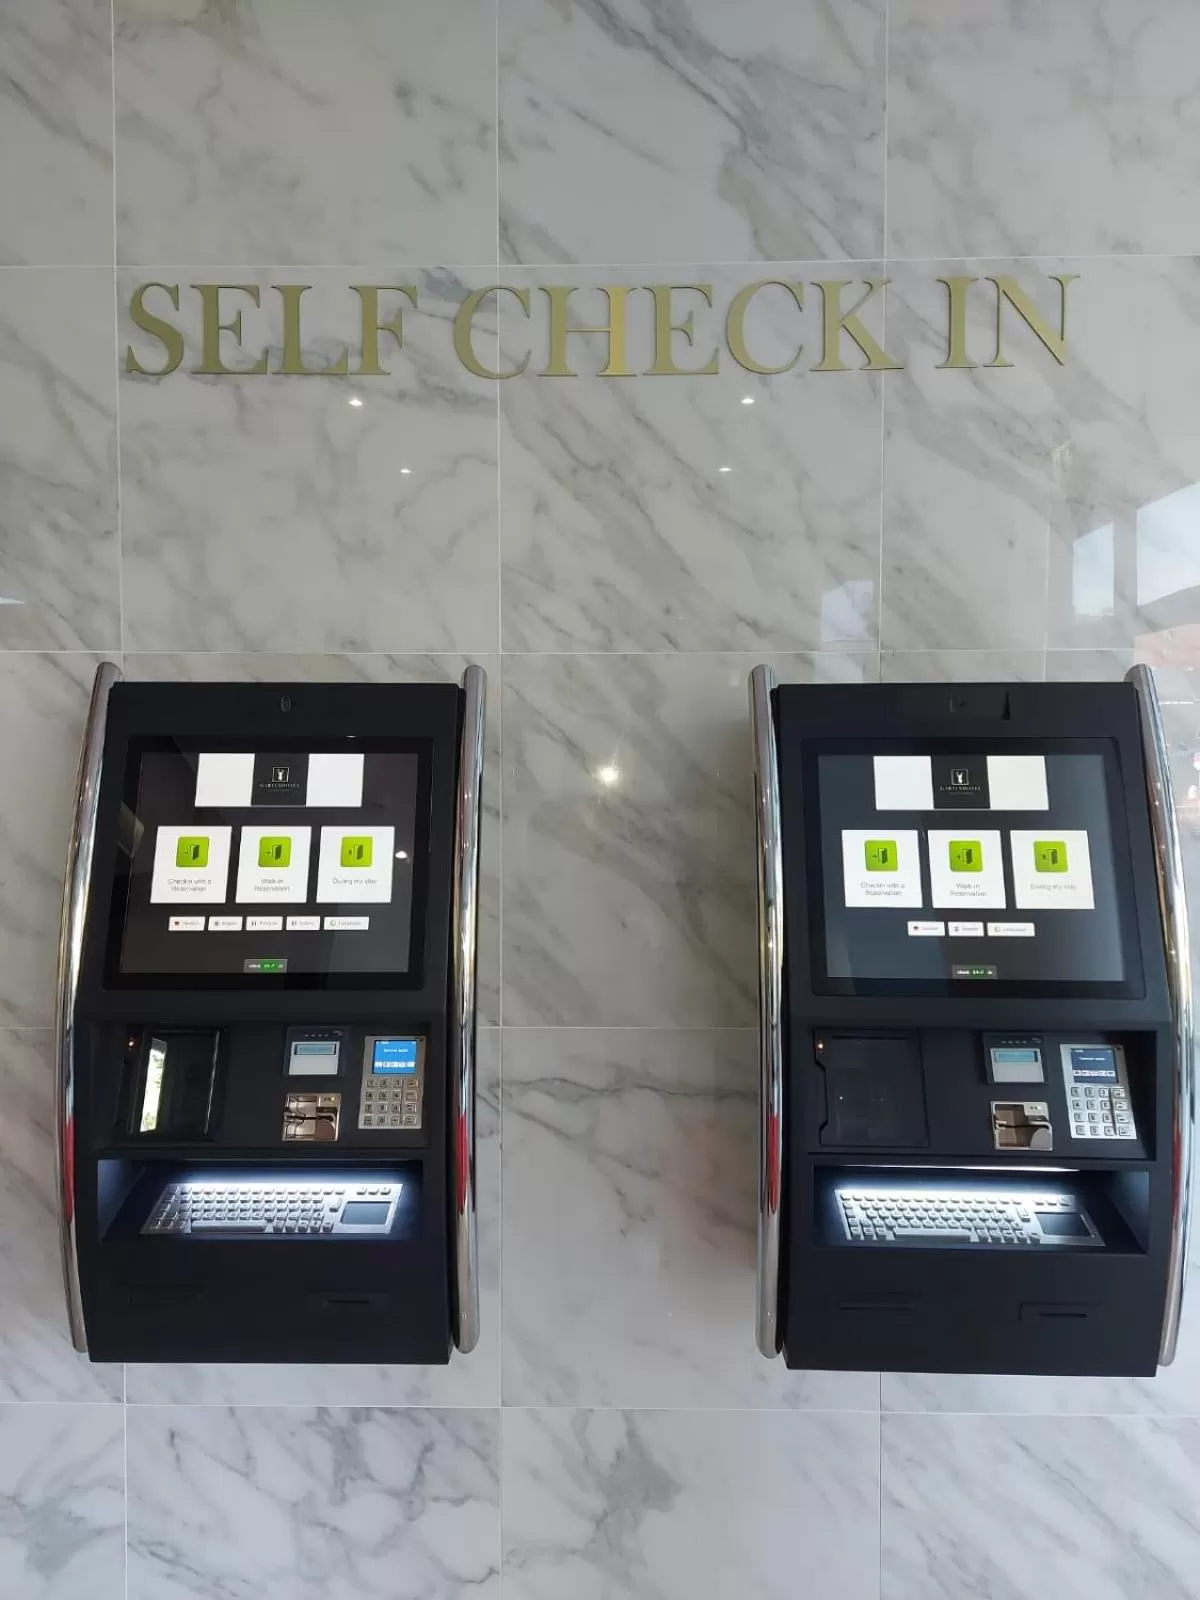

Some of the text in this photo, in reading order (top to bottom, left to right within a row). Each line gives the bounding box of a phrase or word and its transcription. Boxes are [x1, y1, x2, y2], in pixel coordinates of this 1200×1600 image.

[126, 274, 1081, 380] SELF CHECK IN
